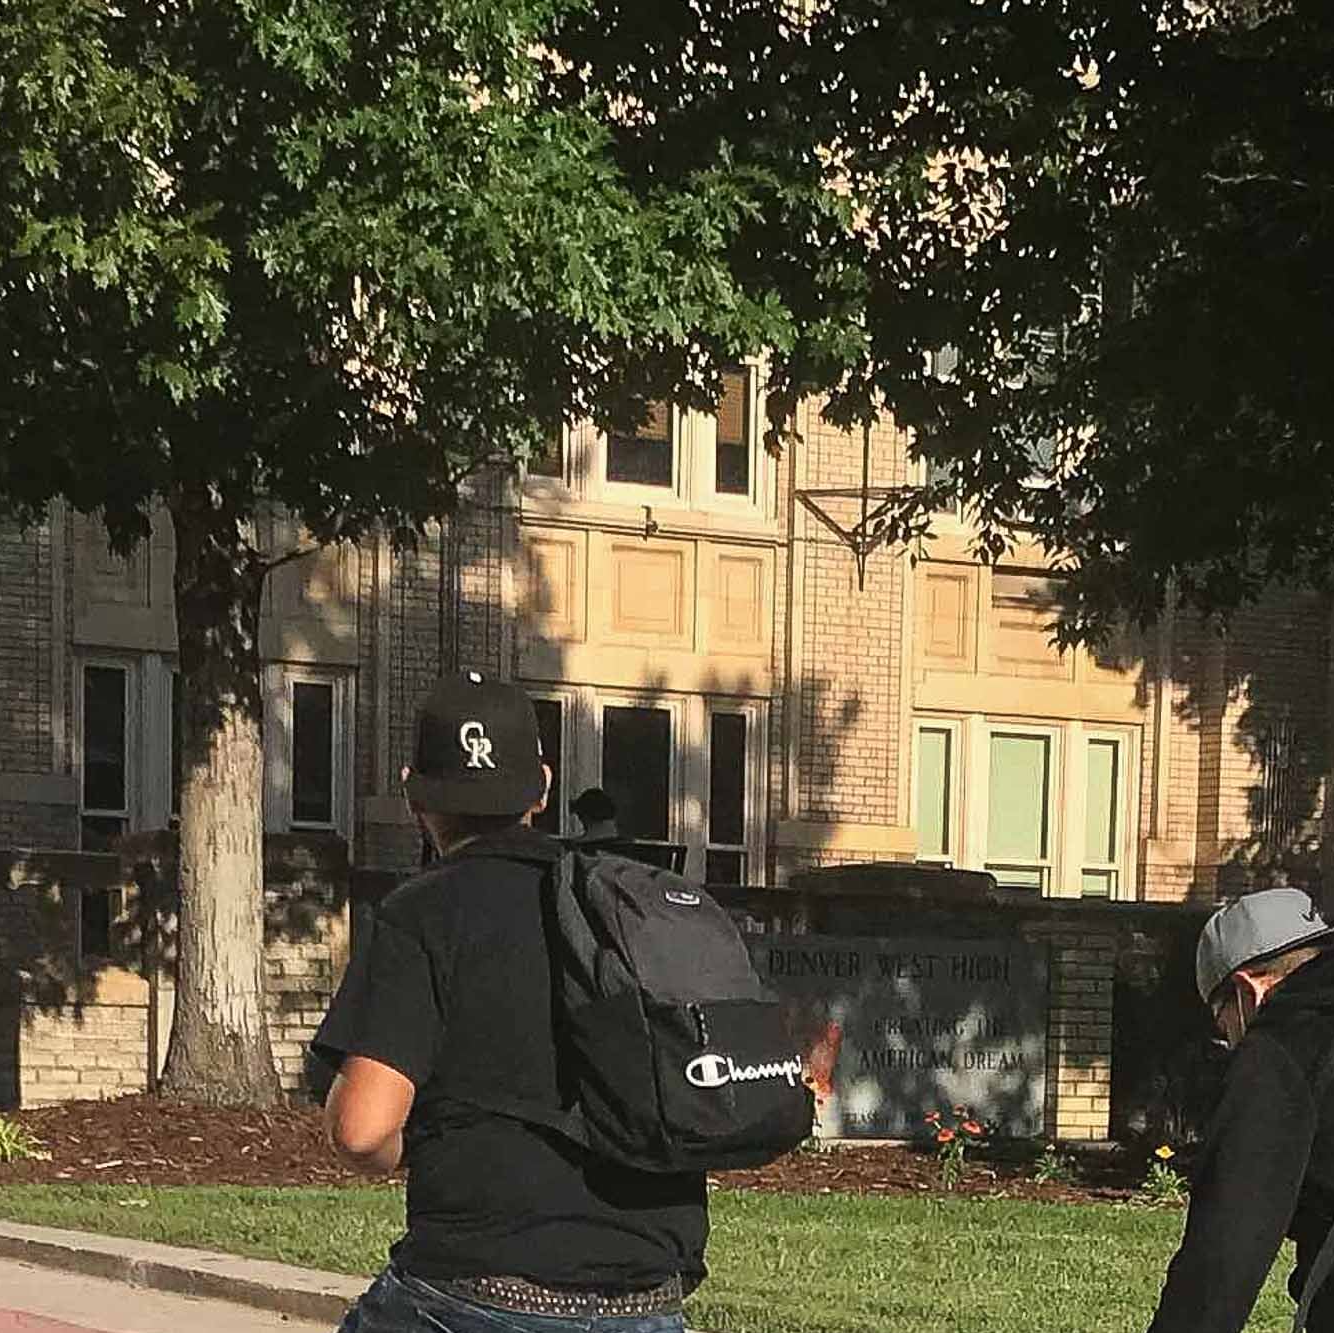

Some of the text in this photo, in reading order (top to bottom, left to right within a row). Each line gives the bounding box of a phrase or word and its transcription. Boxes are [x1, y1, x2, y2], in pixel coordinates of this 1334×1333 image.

[768, 949, 860, 977] DENVER
[875, 952, 940, 978] WEST
[859, 1050, 1025, 1070] AMERICAN DREAM
